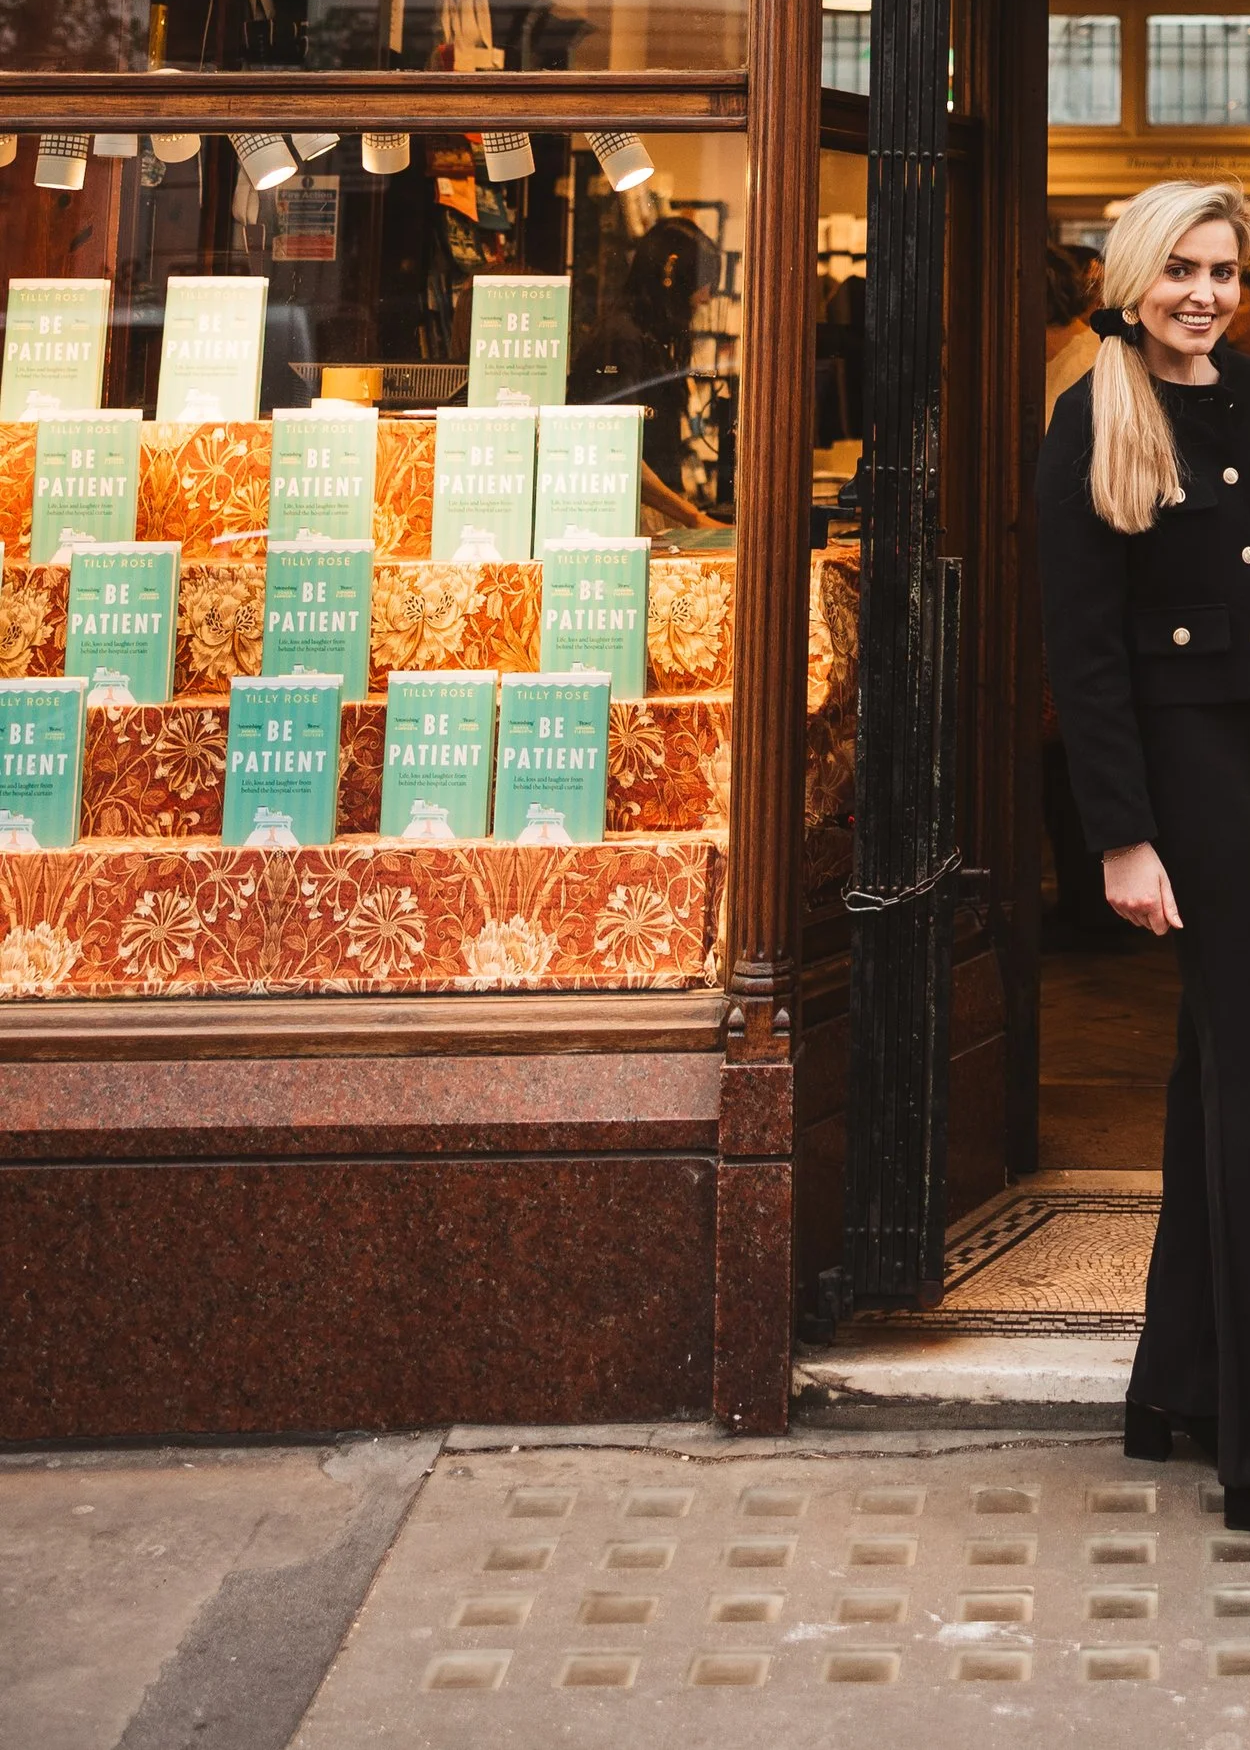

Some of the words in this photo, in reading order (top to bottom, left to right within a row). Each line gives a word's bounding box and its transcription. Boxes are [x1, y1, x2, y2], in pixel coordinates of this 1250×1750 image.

[39, 315, 62, 335] BE
[200, 313, 221, 333] BE
[508, 313, 530, 331] BE
[7, 342, 91, 361] PATIENT
[166, 340, 252, 358] PATIENT
[476, 340, 560, 358] PATIENT
[71, 449, 95, 469] BE
[307, 448, 330, 468] BE
[471, 447, 494, 466] BE
[573, 445, 597, 465] BE
[38, 477, 127, 497] PATIENT
[274, 478, 362, 497] PATIENT
[440, 475, 525, 494] PATIENT
[542, 474, 629, 494] PATIENT
[281, 558, 312, 566] TILLY
[318, 558, 351, 566] ROSE
[105, 584, 129, 604] BE
[302, 582, 326, 602] BE
[580, 580, 604, 600] BE
[72, 613, 162, 634] PATIENT
[269, 611, 359, 632] PATIENT
[546, 610, 637, 630] PATIENT
[246, 695, 278, 703] TILLY
[284, 694, 318, 703] ROSE
[403, 689, 435, 698] TILLY
[441, 689, 474, 698] ROSE
[517, 691, 549, 699] TILLY
[556, 691, 589, 700] ROSE
[10, 723, 35, 744] BE
[268, 720, 293, 742] BE
[424, 714, 449, 735] BE
[540, 717, 564, 739] BE
[0, 754, 68, 776] TIENT
[232, 751, 326, 772] PATIENT
[389, 744, 481, 766] PATIENT
[504, 748, 598, 769] PATIENT
